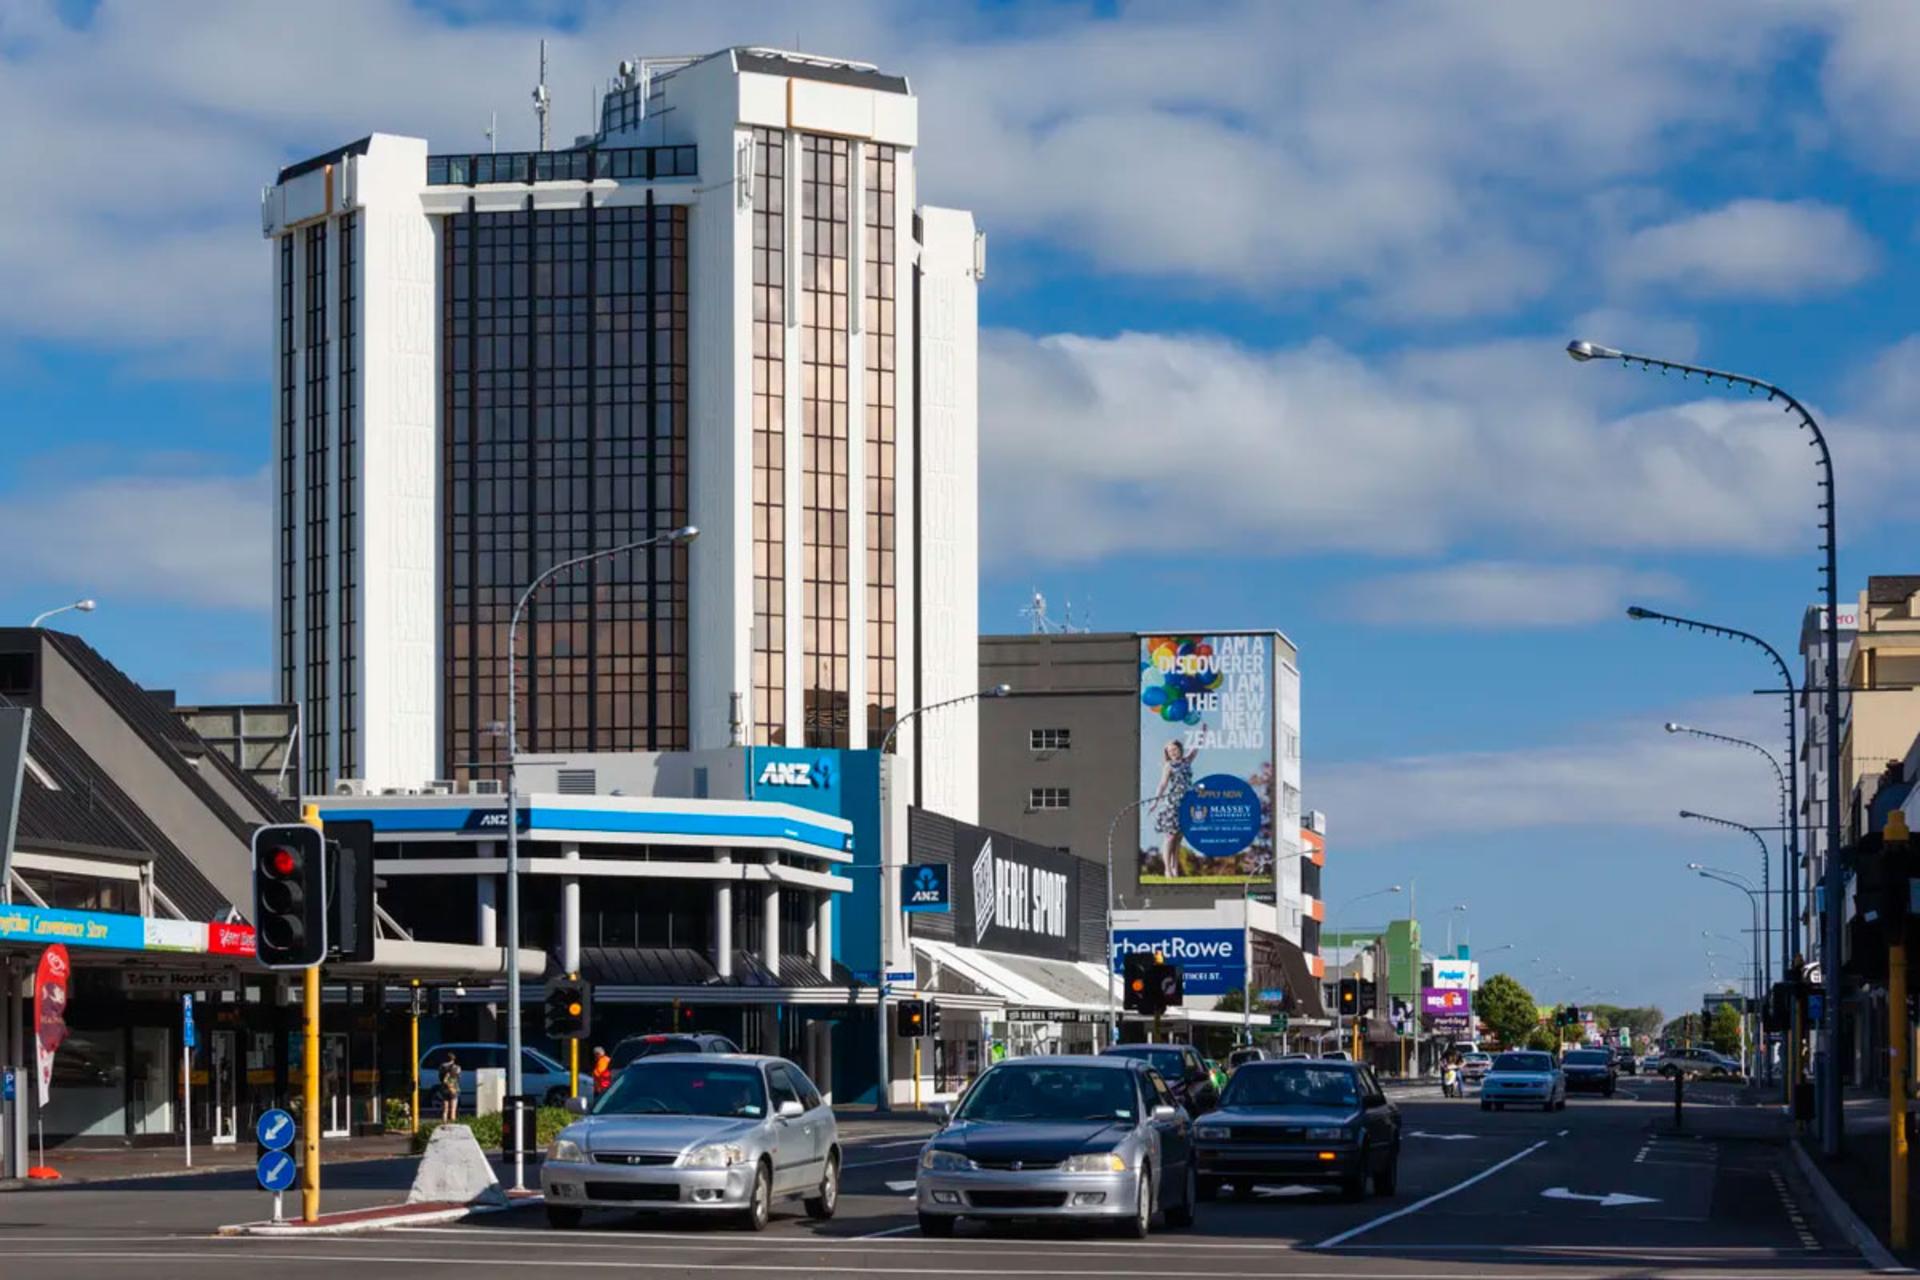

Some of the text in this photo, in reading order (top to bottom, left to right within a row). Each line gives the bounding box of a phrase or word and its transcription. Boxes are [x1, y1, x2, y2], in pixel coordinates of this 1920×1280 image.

[1213, 637, 1265, 655] I AM A
[1158, 655, 1264, 674] DISCOVERER
[1228, 675, 1264, 692] I AM
[1185, 693, 1265, 711] THE NEW
[1222, 711, 1265, 730] NEW
[1184, 731, 1264, 749] ZEALAND
[759, 762, 811, 786] ANZ
[1222, 790, 1243, 799] NOW
[1210, 804, 1251, 813] MASSEY
[480, 814, 508, 826] ANZ
[912, 891, 939, 902] ANZ
[996, 858, 1067, 938] REBEL SPORT
[33, 914, 85, 938] Convenience
[87, 919, 108, 940] Store
[1107, 936, 1233, 958] rbertRowe
